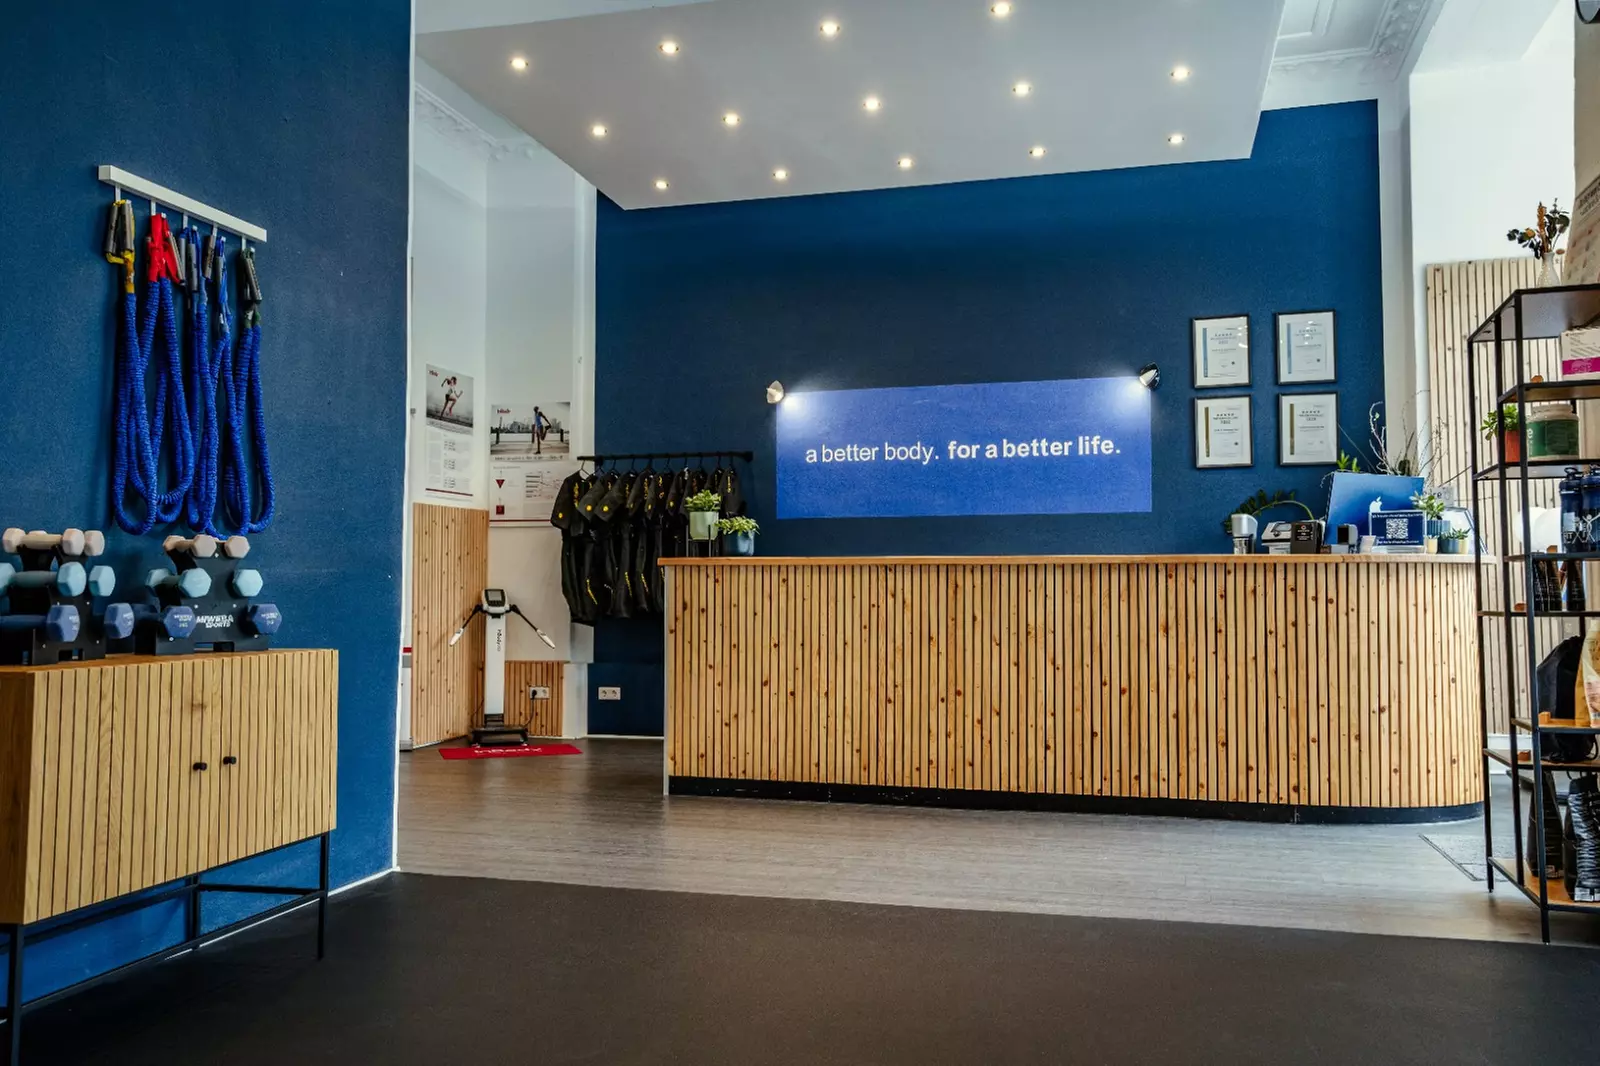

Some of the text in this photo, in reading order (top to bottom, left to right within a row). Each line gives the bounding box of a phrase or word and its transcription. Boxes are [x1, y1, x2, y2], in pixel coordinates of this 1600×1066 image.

[805, 434, 1121, 465] a better body. for a better life.
